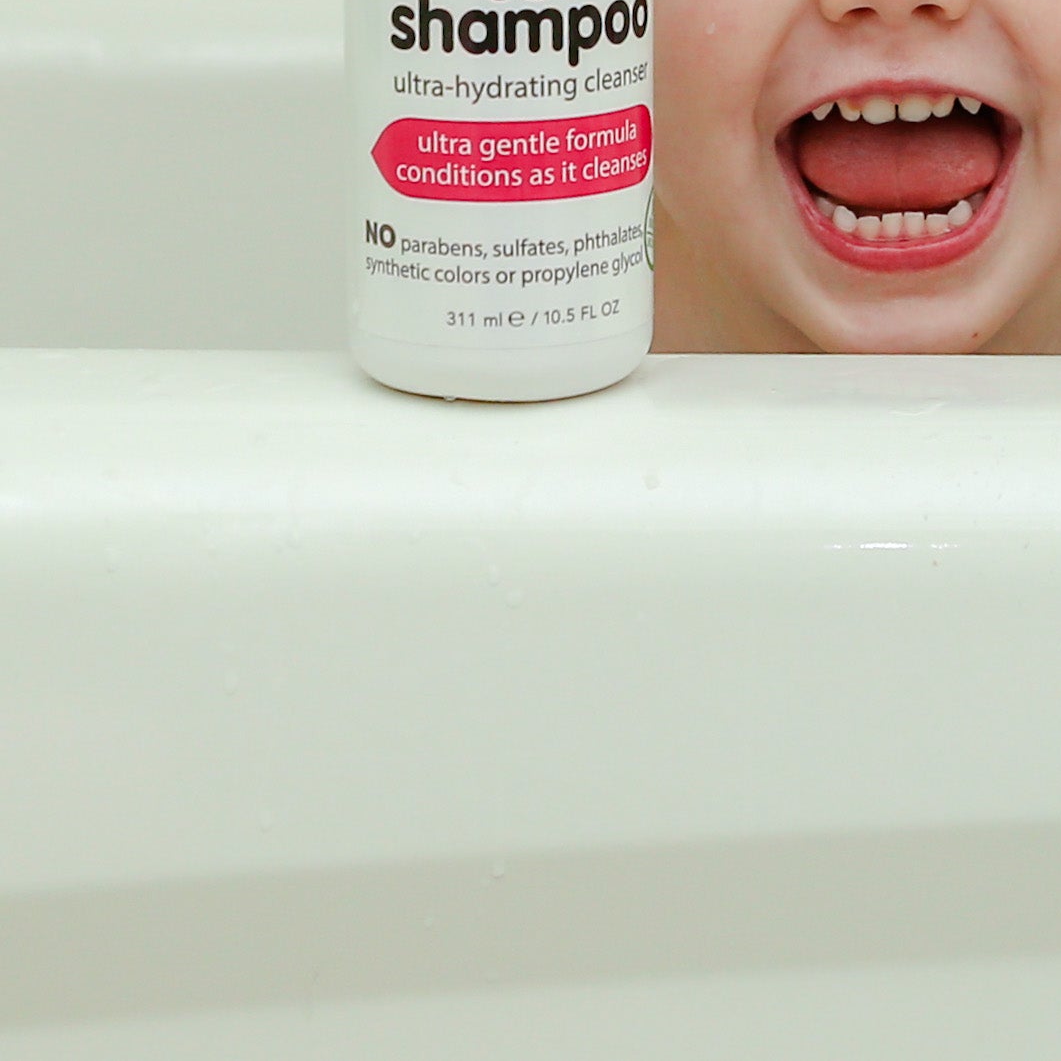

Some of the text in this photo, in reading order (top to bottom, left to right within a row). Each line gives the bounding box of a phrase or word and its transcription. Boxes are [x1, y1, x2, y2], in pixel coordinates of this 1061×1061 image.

[393, 61, 648, 105] ultra-hydrating cleanser
[417, 119, 637, 161] ultra gentle formula
[396, 147, 648, 187] conditions as it cleanses
[365, 218, 396, 249] NO
[401, 236, 488, 260] parabens,
[493, 238, 569, 258] sulfates,
[366, 247, 644, 287] synthetic colors or propylene glycol
[446, 311, 476, 327] 311
[483, 311, 503, 327] ml
[531, 310, 538, 326] /
[544, 306, 575, 325] 10.5
[580, 305, 597, 321] FL
[601, 298, 620, 317] OZ
